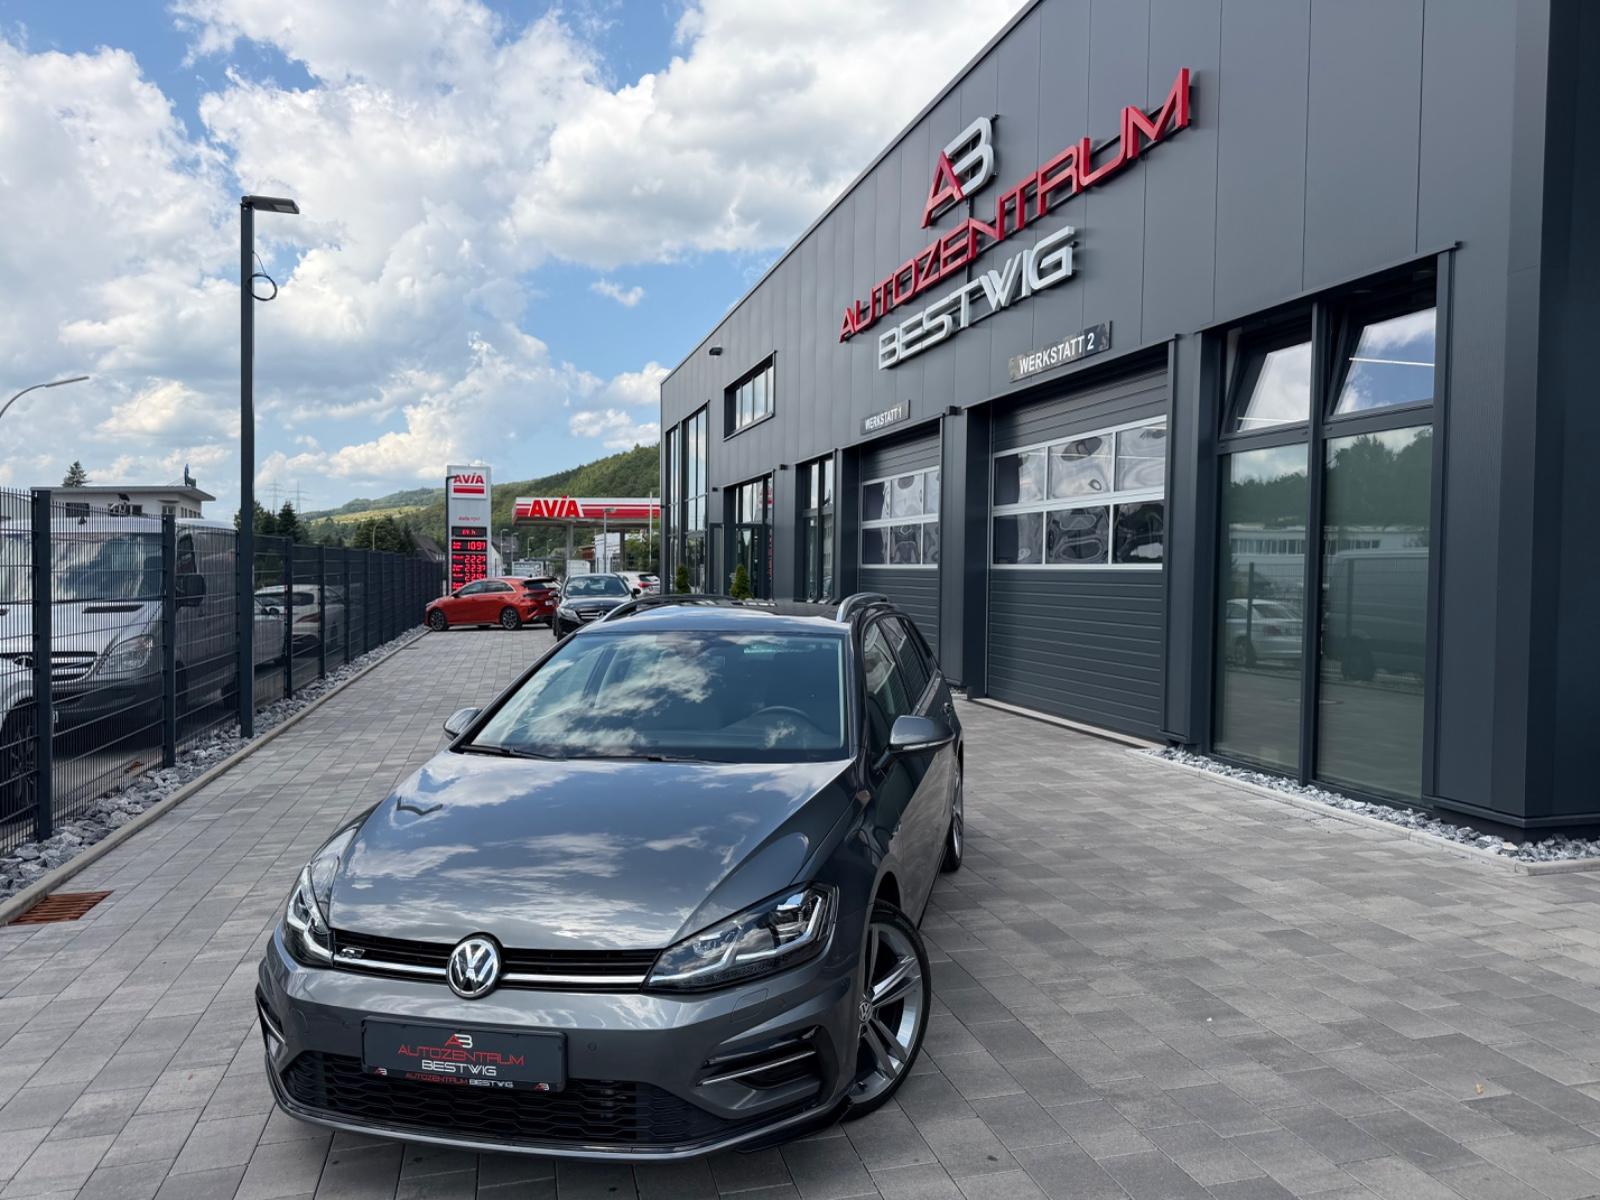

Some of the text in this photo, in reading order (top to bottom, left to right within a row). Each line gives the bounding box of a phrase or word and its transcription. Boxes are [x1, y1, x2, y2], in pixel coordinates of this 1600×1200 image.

[839, 67, 1190, 343] AUTOZENTRUM
[879, 225, 1075, 371] BESTWIG
[1020, 332, 1095, 375] WERKSTATT 2
[865, 407, 898, 431] WERKSTATT
[453, 472, 484, 485] AVIA
[528, 496, 584, 518] AVIA
[397, 1044, 525, 1066] AUTOZENTRUM
[421, 1059, 497, 1077] BESTWIG
[404, 1072, 469, 1087] AUTOZENTRUM
[469, 1078, 514, 1089] BESTWIG
